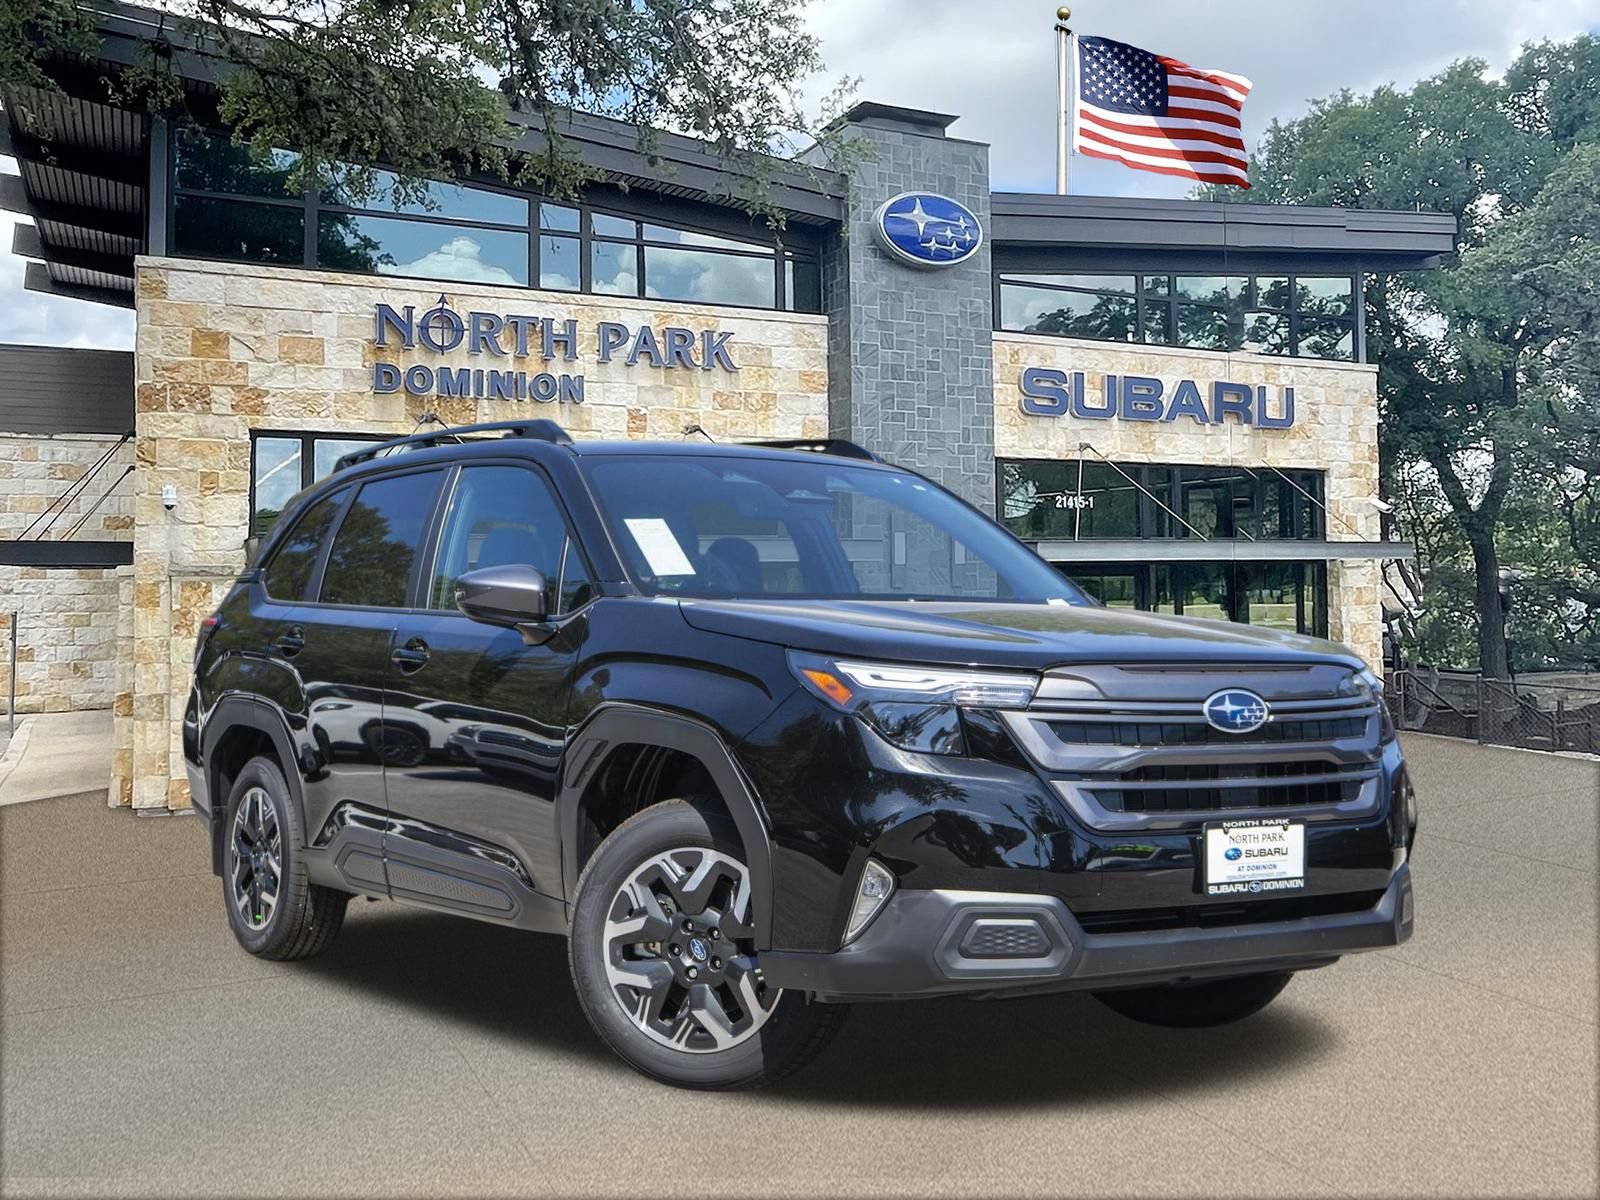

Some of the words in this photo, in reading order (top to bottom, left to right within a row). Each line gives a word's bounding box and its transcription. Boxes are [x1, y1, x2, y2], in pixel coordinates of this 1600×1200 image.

[374, 292, 579, 362] NORTH
[596, 321, 741, 373] PARK
[373, 362, 585, 404] DOMINION
[1018, 367, 1295, 430] SUBARU
[1222, 820, 1260, 828] NORTH
[1262, 818, 1290, 826] PARK
[1229, 833, 1259, 845] NORTH
[1261, 832, 1286, 843] PARK
[1244, 847, 1289, 858] SUBARU
[1246, 863, 1277, 872] DOMINION
[1208, 882, 1248, 895] SUBARU
[1262, 878, 1304, 890] DOMINION
